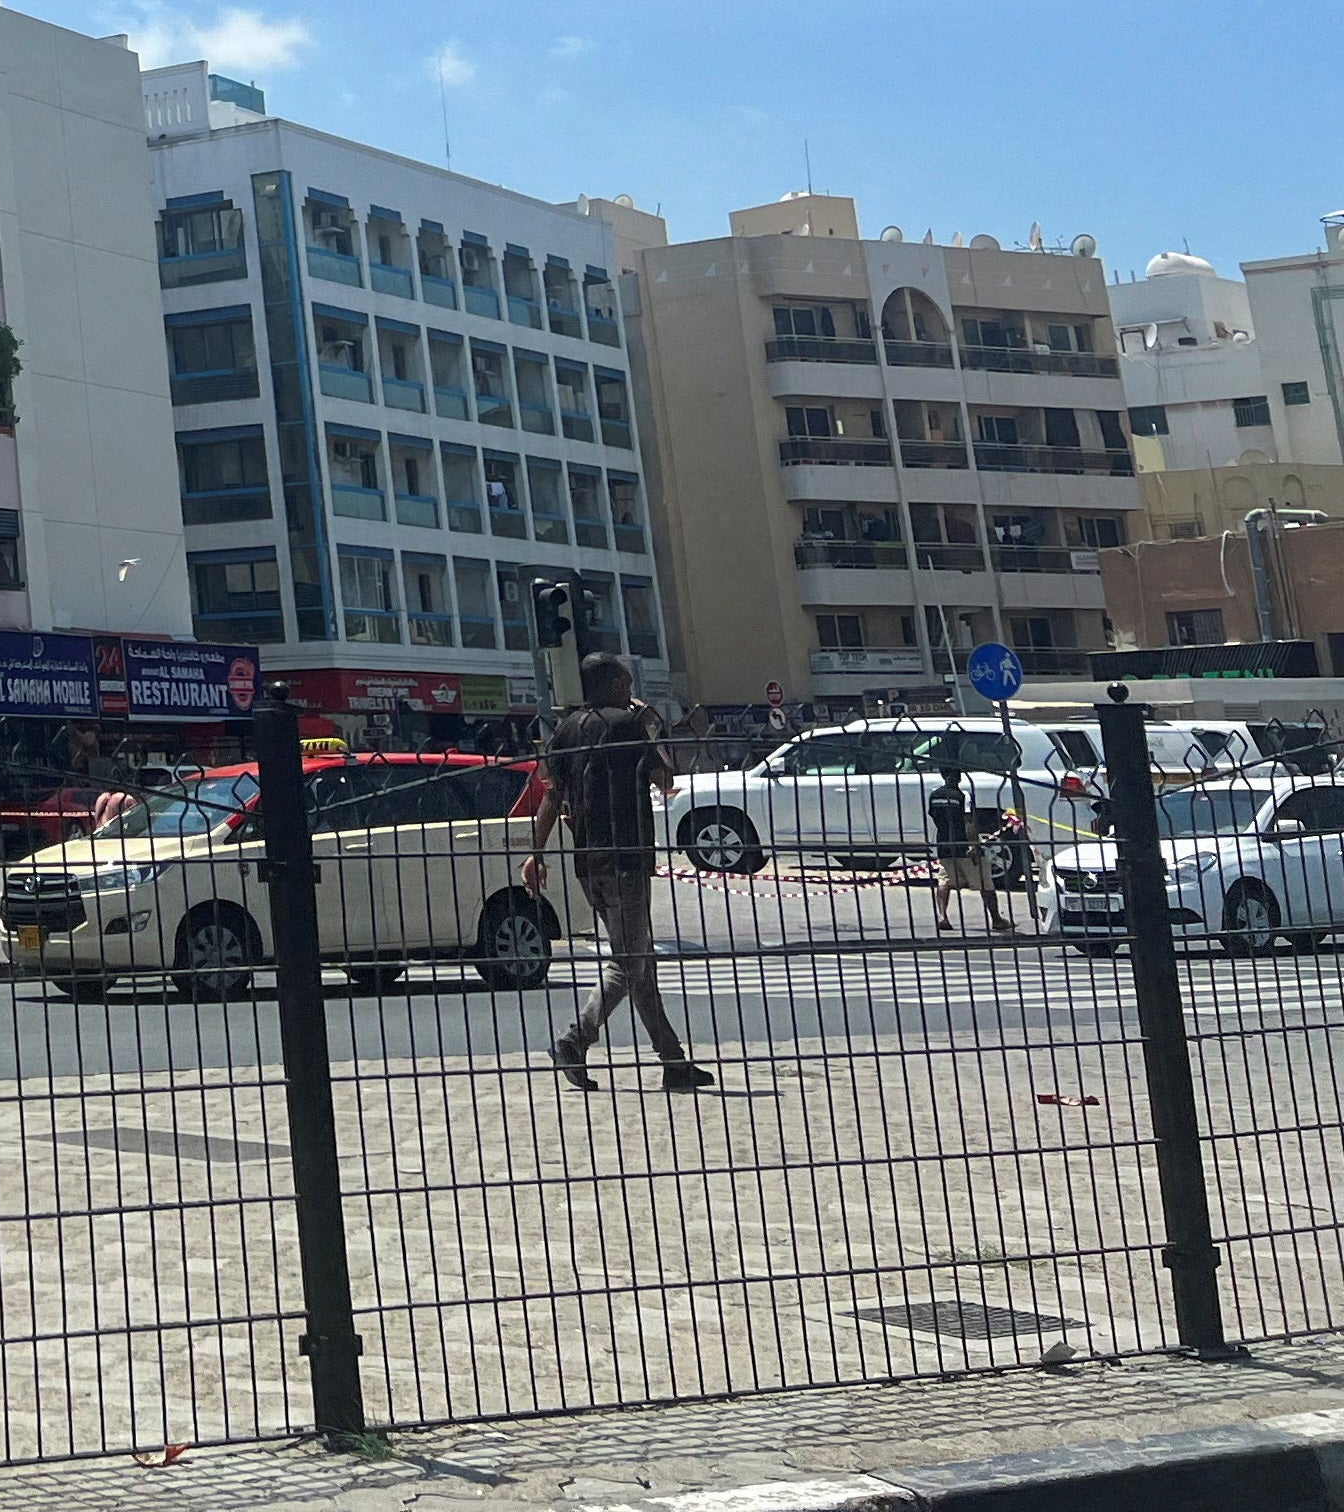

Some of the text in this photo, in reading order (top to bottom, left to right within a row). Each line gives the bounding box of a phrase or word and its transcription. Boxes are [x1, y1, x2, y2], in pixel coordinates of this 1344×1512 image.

[95, 644, 124, 676] 24
[159, 665, 170, 679] AL
[171, 666, 206, 681] SAMAHA
[7, 677, 52, 706] SAMAHA
[52, 679, 91, 705] MOBILE
[130, 679, 228, 708] RESTAURANT
